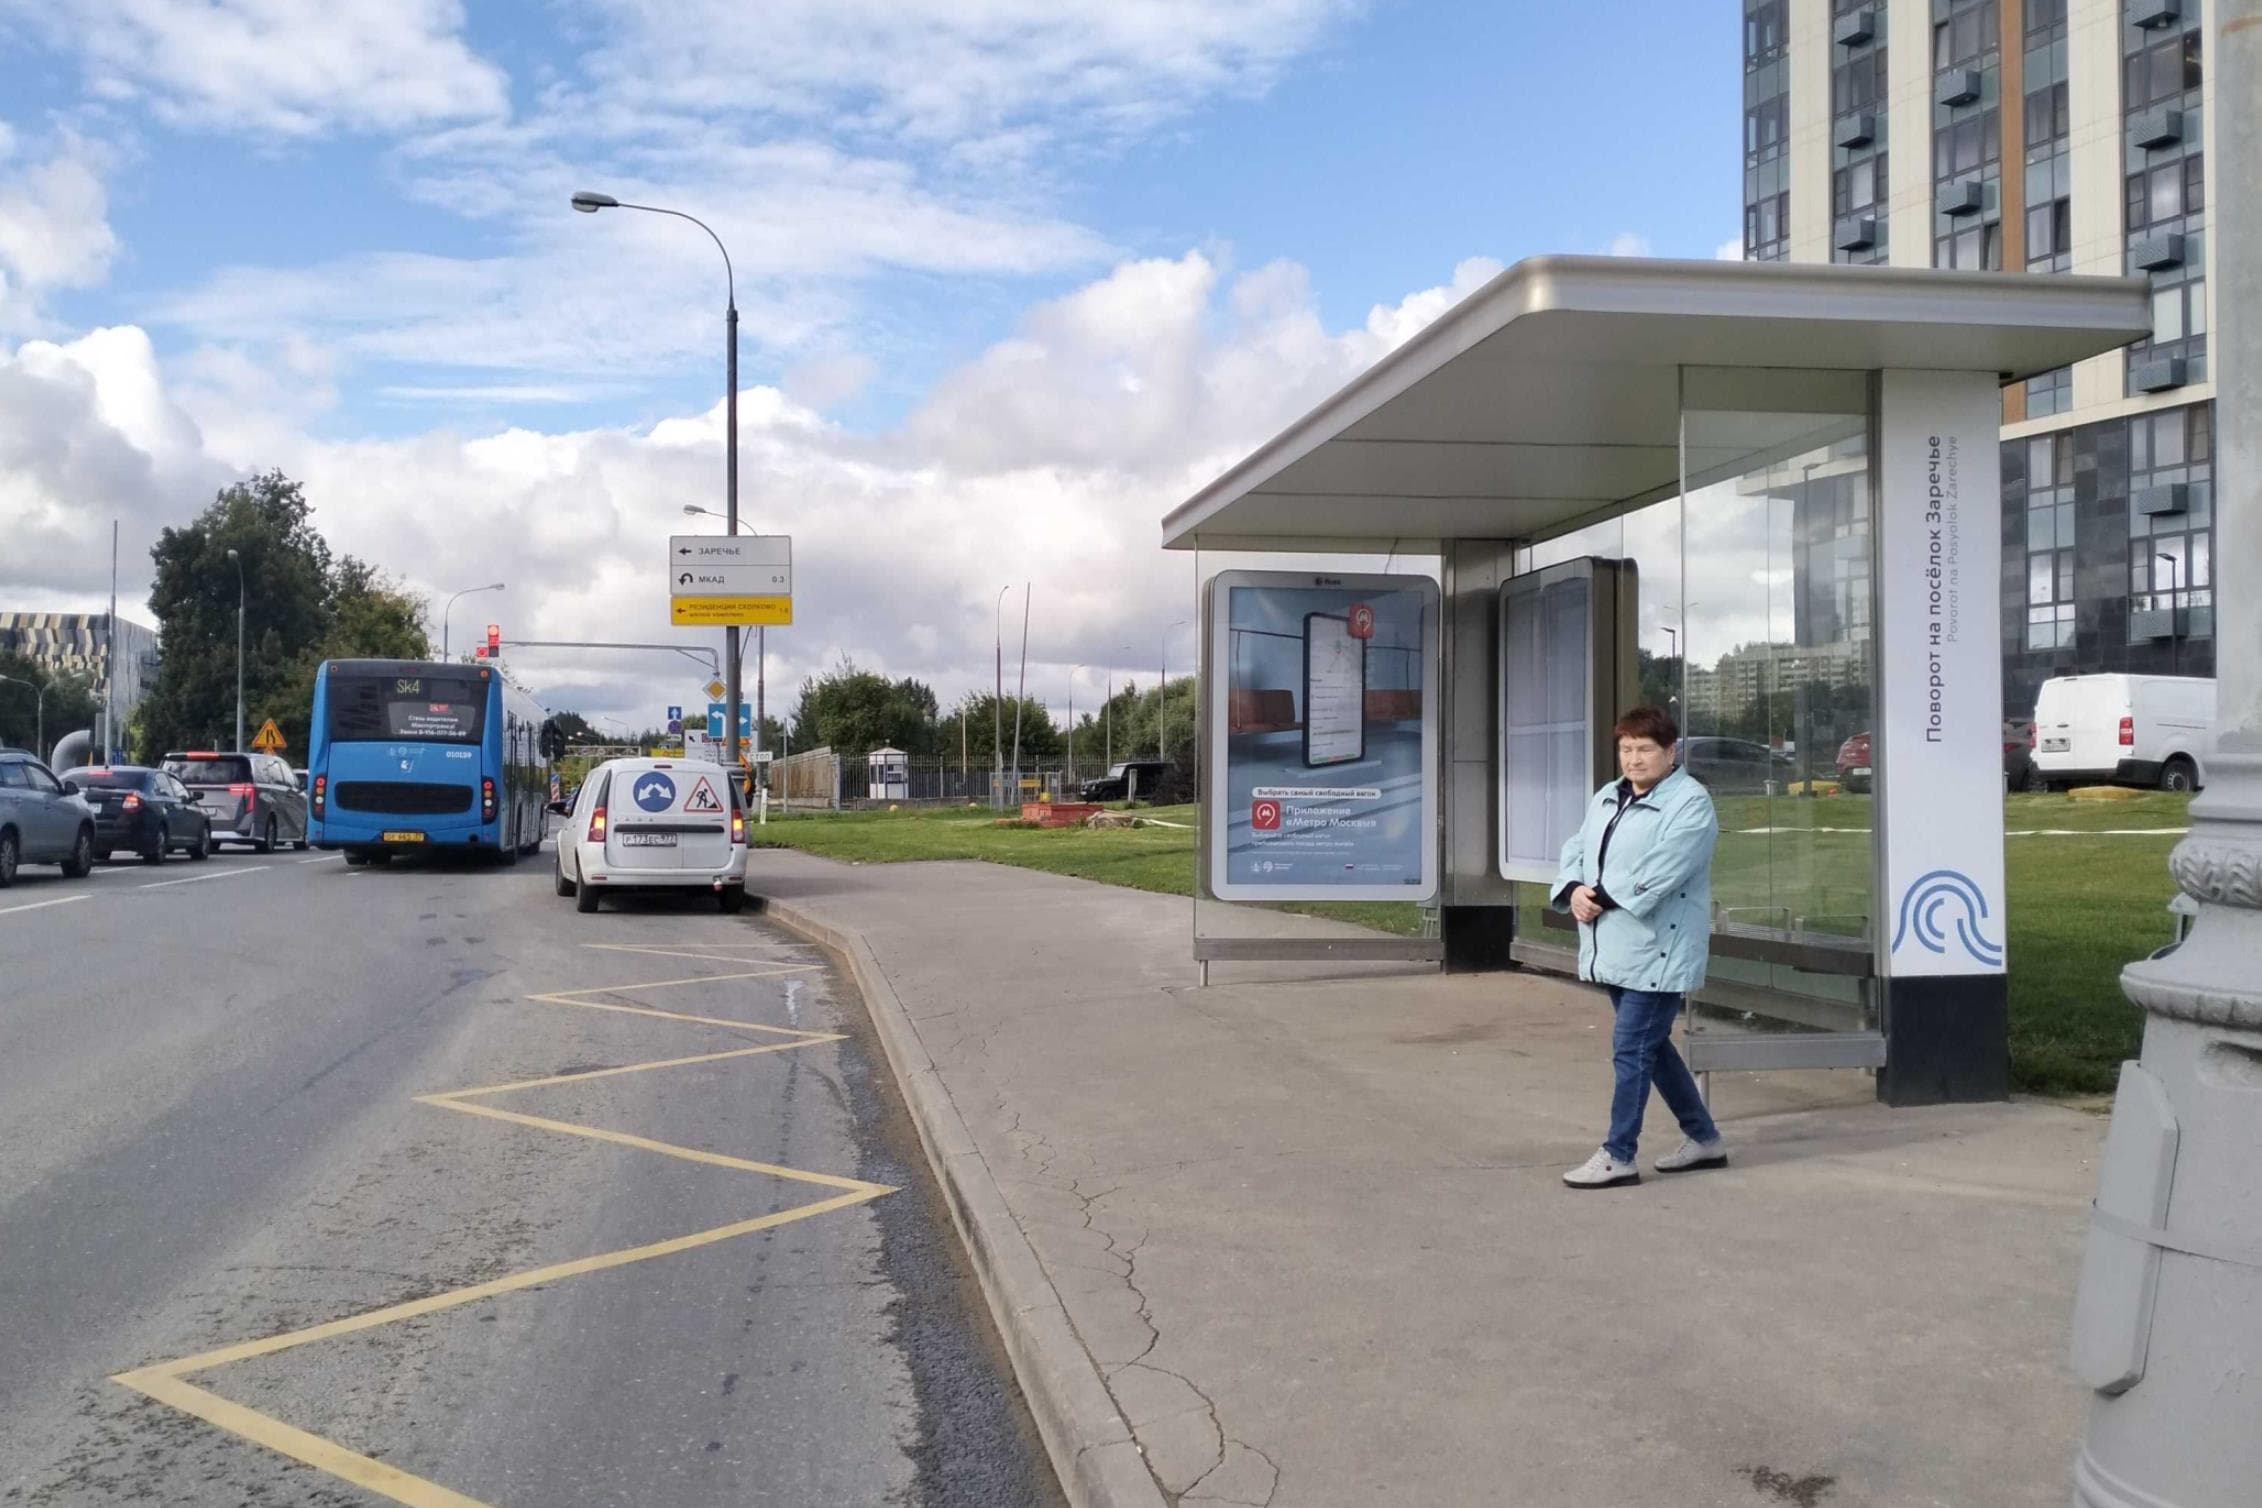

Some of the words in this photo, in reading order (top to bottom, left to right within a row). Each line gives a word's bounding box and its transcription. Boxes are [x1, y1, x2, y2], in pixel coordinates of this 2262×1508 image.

[1925, 436, 1944, 523] Заречье
[1946, 436, 1960, 499] Zarechye
[698, 547, 741, 555] ЗАРЕЧЬЕ
[1947, 503, 1960, 564] Posyolok
[698, 576, 725, 584] МКАД
[1925, 530, 1941, 614] посёлок
[1949, 569, 1958, 585] na
[1929, 622, 1941, 645] на
[1947, 590, 1959, 643] Povorot
[1925, 651, 1944, 742] Поворот
[1257, 789, 1288, 797] Выбрать
[1290, 789, 1313, 797] самый
[1315, 789, 1355, 798] свободный
[1286, 806, 1351, 816] Приложение
